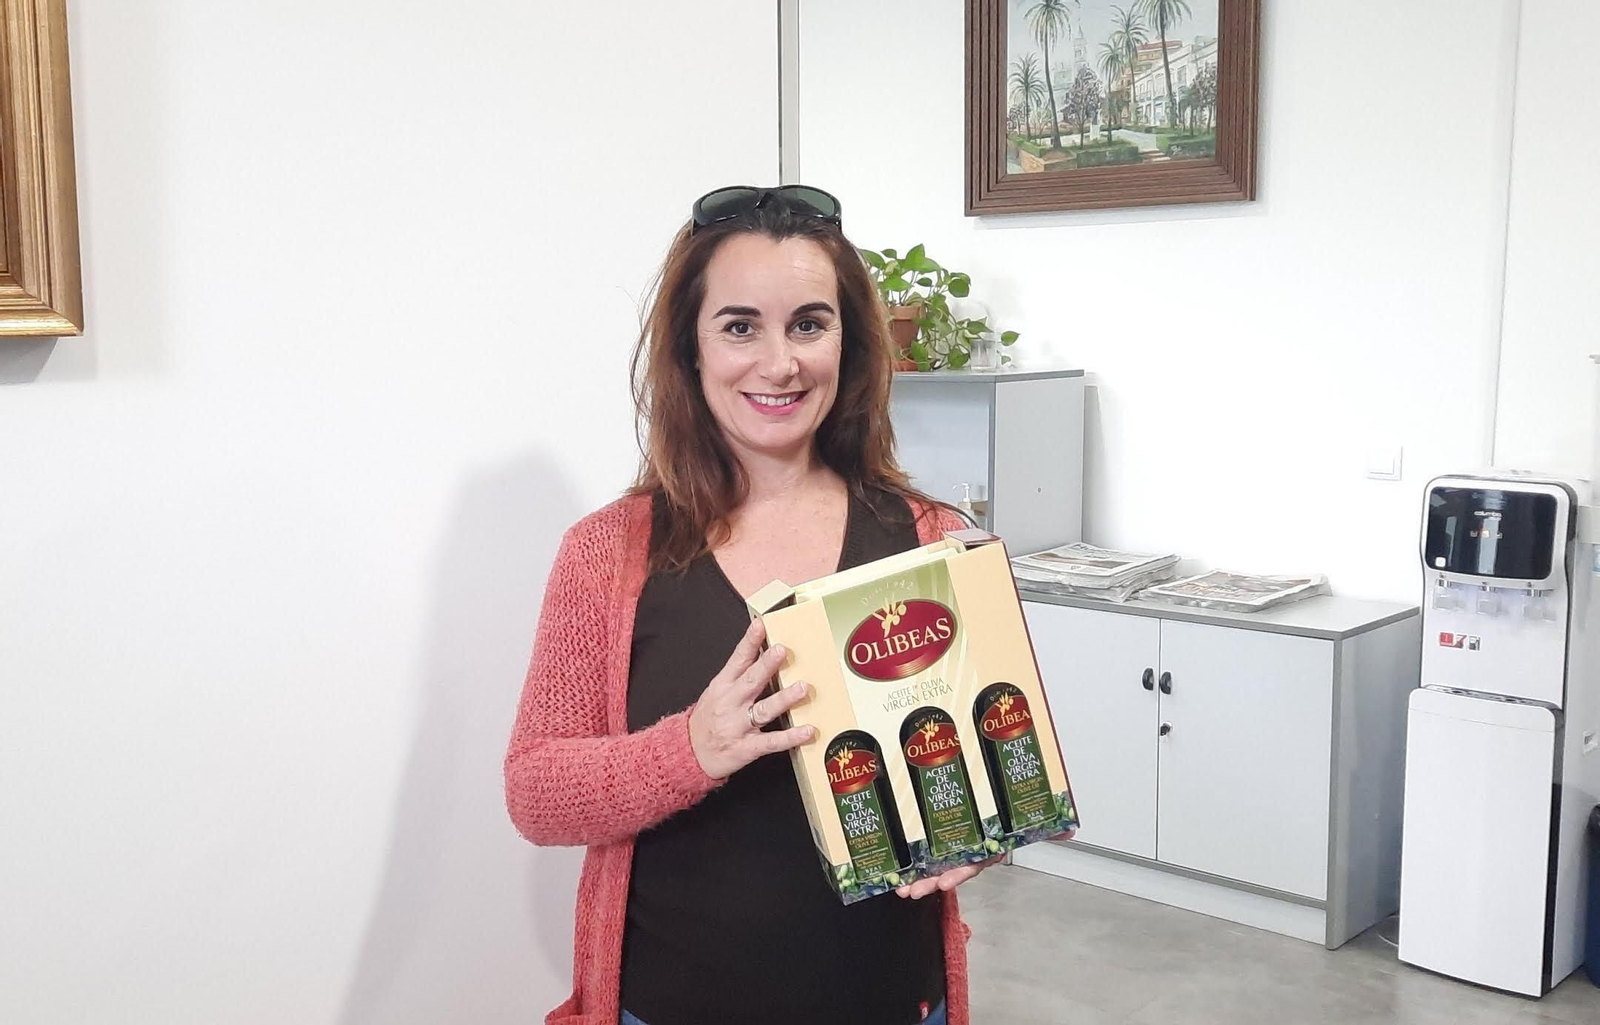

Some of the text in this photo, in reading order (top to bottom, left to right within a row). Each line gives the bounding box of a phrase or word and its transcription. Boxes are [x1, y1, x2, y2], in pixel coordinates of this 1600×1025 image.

[887, 686, 911, 701] ACEITE
[920, 677, 944, 690] OLIVA
[882, 683, 953, 712] VIRGEN EXTRA
[1002, 735, 1032, 752] ACEITE
[1013, 747, 1026, 757] DE
[1005, 759, 1041, 776] VIRGEN
[1007, 753, 1036, 767] OLIVA
[925, 763, 957, 779] ACEITE
[1011, 769, 1040, 784] EXTRA
[936, 775, 950, 785] DE
[930, 781, 959, 795] OLIVA
[840, 790, 871, 806] ACEITE
[928, 788, 964, 804] VIRGEN
[851, 801, 865, 811] DE
[933, 797, 963, 811] EXTRA
[845, 807, 875, 821] OLIVA
[843, 814, 880, 831] VIRGEN
[849, 823, 879, 838] EXTRA
